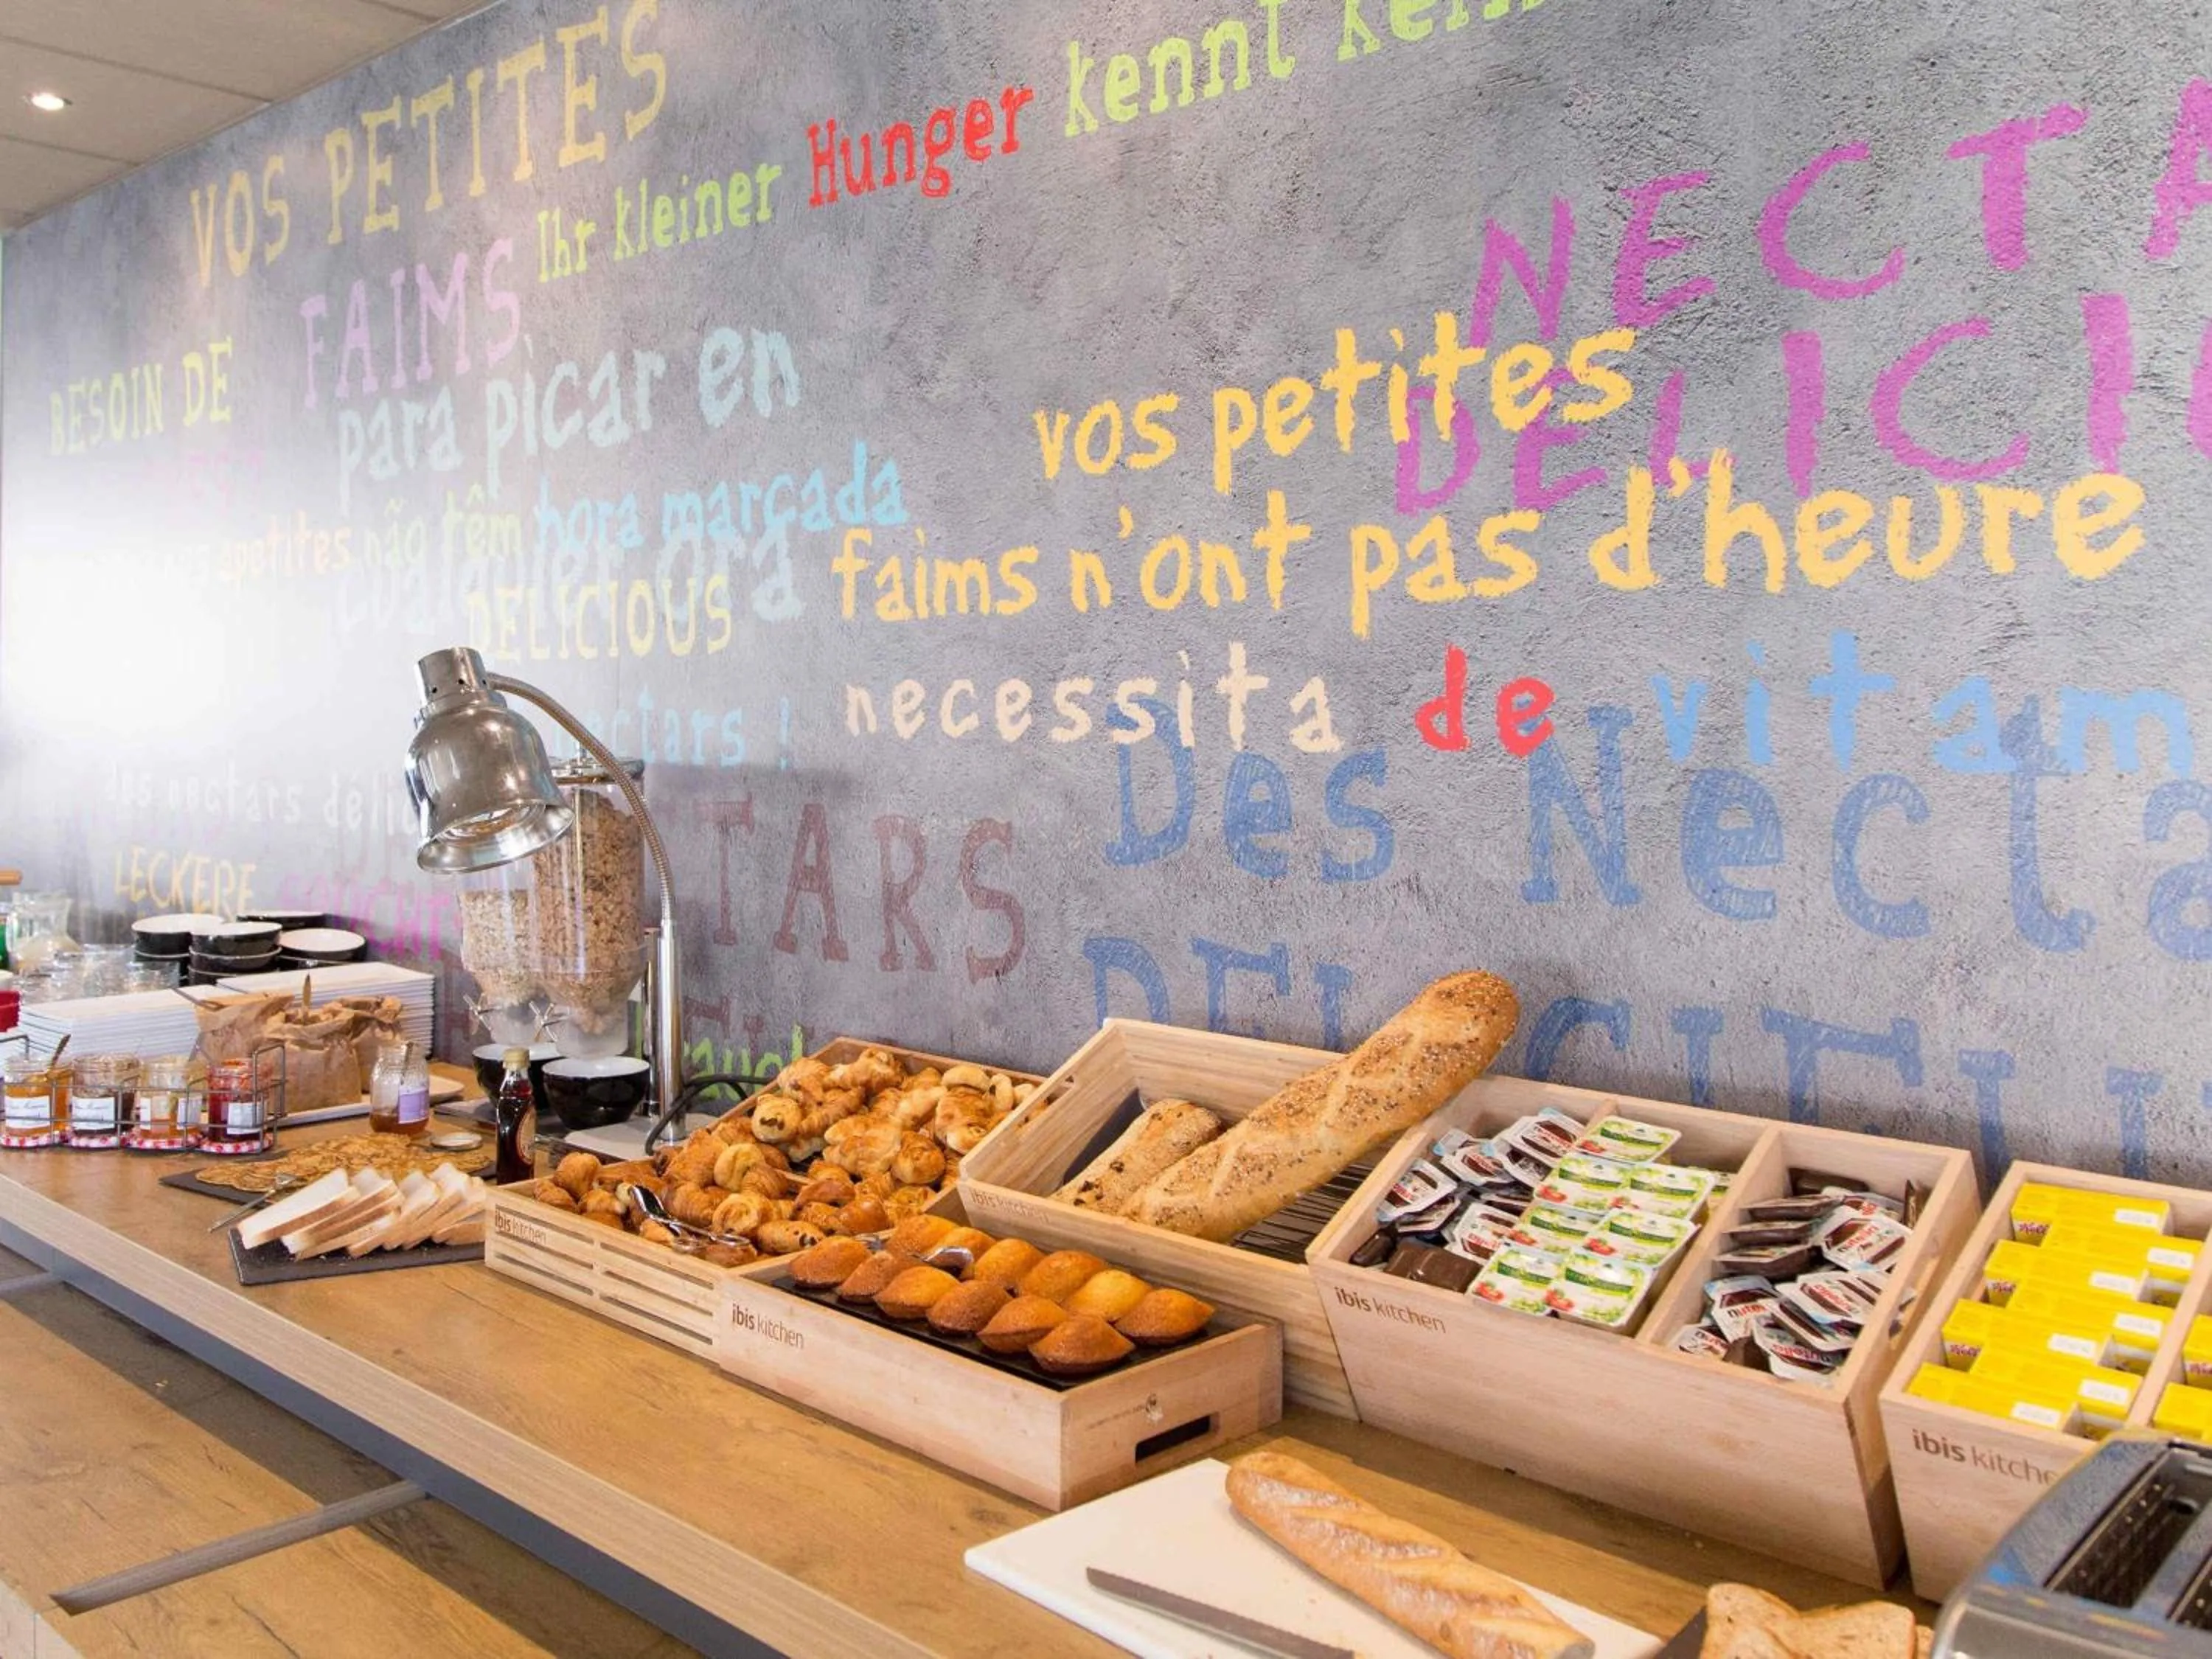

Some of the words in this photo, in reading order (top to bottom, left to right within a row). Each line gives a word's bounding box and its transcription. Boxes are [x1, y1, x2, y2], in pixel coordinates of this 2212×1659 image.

[190, 155, 290, 288] VOS
[324, 0, 667, 246] PETITES
[538, 207, 597, 283] Ihr
[613, 163, 782, 261] kleiner
[806, 86, 1035, 209] Hunger
[1065, 0, 1295, 137] kennt
[49, 362, 164, 457] BESOIN
[182, 336, 232, 427] DE
[299, 238, 520, 409] FAIMS
[338, 386, 462, 516] para
[485, 333, 667, 500] picar
[698, 327, 801, 428] en
[1034, 391, 1180, 479] vos
[1213, 310, 1635, 495] petites
[532, 470, 645, 552] hora
[661, 441, 910, 543] marcada
[831, 528, 1040, 622] faims
[1349, 508, 1543, 641] pas
[1587, 447, 2147, 594] d'heure
[467, 572, 733, 661] DELICIOUS
[845, 641, 1343, 754] necessita
[1413, 641, 1556, 760] de
[1645, 628, 2196, 781] vitam
[1105, 698, 1396, 886] Des
[1520, 692, 2212, 961] Necta
[495, 1209, 512, 1234] ibis
[512, 1218, 547, 1246] kitchen
[731, 1301, 756, 1332] ibis
[757, 1310, 805, 1349] kitchen
[1334, 1286, 1371, 1312] ibis
[1371, 1295, 1447, 1335] kitchen
[1911, 1428, 1967, 1463] ibis
